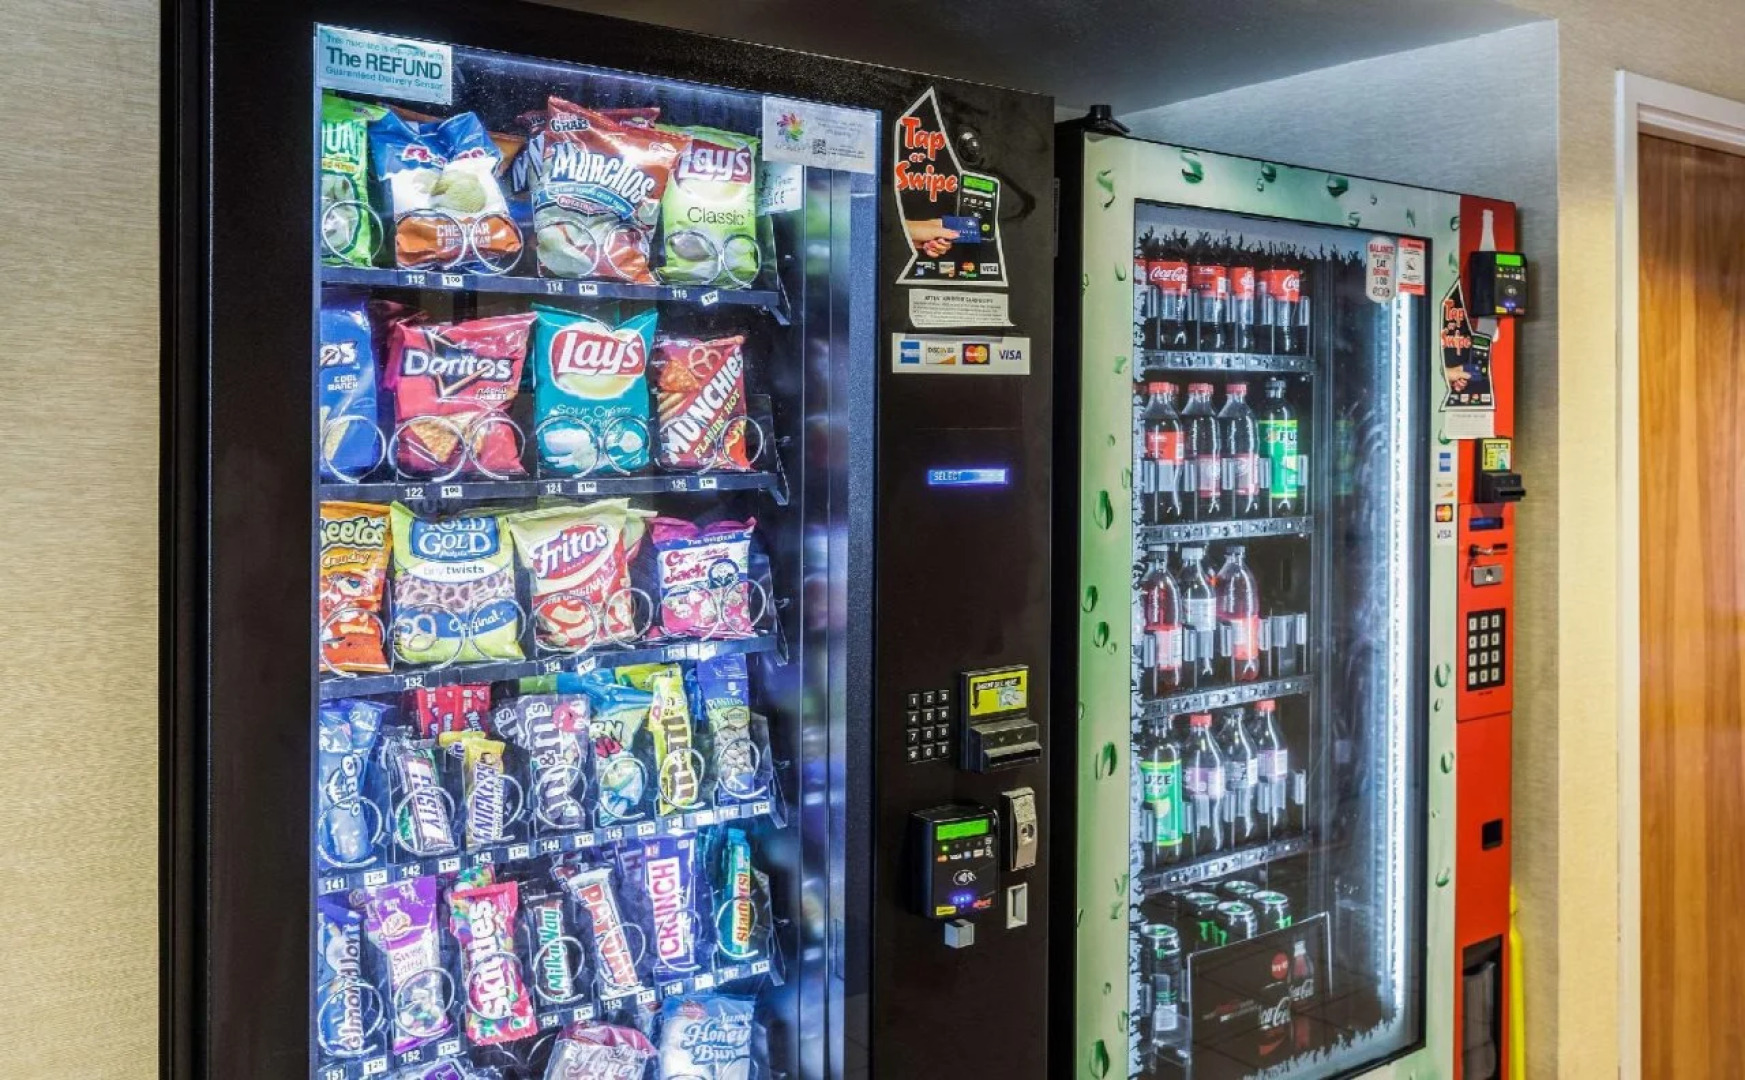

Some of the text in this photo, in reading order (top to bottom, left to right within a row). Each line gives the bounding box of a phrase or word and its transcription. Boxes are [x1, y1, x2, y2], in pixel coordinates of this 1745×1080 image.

[326, 45, 443, 80] The REFUND
[415, 79, 444, 90] Sensor
[900, 116, 946, 161] Tap
[909, 152, 926, 163] or
[551, 141, 656, 204] MUNCHOS
[895, 160, 958, 203] Swipe
[686, 206, 745, 226] Classic
[1369, 243, 1394, 254] BALANCE
[1373, 267, 1390, 277] DRINK
[406, 274, 425, 284] 112
[547, 283, 563, 293] 114
[1444, 299, 1465, 328] Tap
[999, 349, 1022, 361] VISA
[404, 349, 512, 381] Doritos
[327, 381, 359, 391] RANCH
[556, 404, 590, 415] Sour
[933, 471, 961, 480] SELECT
[405, 487, 424, 497] 122
[320, 517, 384, 548] eetos
[419, 532, 492, 555] GOLD
[532, 525, 609, 578] Fritos
[446, 563, 485, 575] twists
[664, 563, 707, 584] Jack
[404, 677, 424, 687] 132
[708, 697, 744, 711] PLANTERS
[926, 694, 932, 703] 2
[941, 693, 947, 701] 3
[911, 733, 916, 741] 7
[926, 748, 932, 756] 0
[1144, 771, 1173, 786] UZE
[473, 762, 501, 842] SNICKERS
[607, 829, 623, 839] 145
[543, 840, 560, 851] 144
[475, 852, 492, 863] 143
[402, 866, 421, 877] 142
[325, 879, 345, 890] 141
[652, 862, 681, 958] CRUNCH
[540, 910, 567, 991] Milky Way
[470, 900, 512, 1019] Skittles
[541, 1016, 558, 1026] 154
[683, 1021, 751, 1048] Honey
[402, 1050, 420, 1062] 152
[693, 1045, 738, 1065] Bun
[325, 1069, 344, 1080] 151
